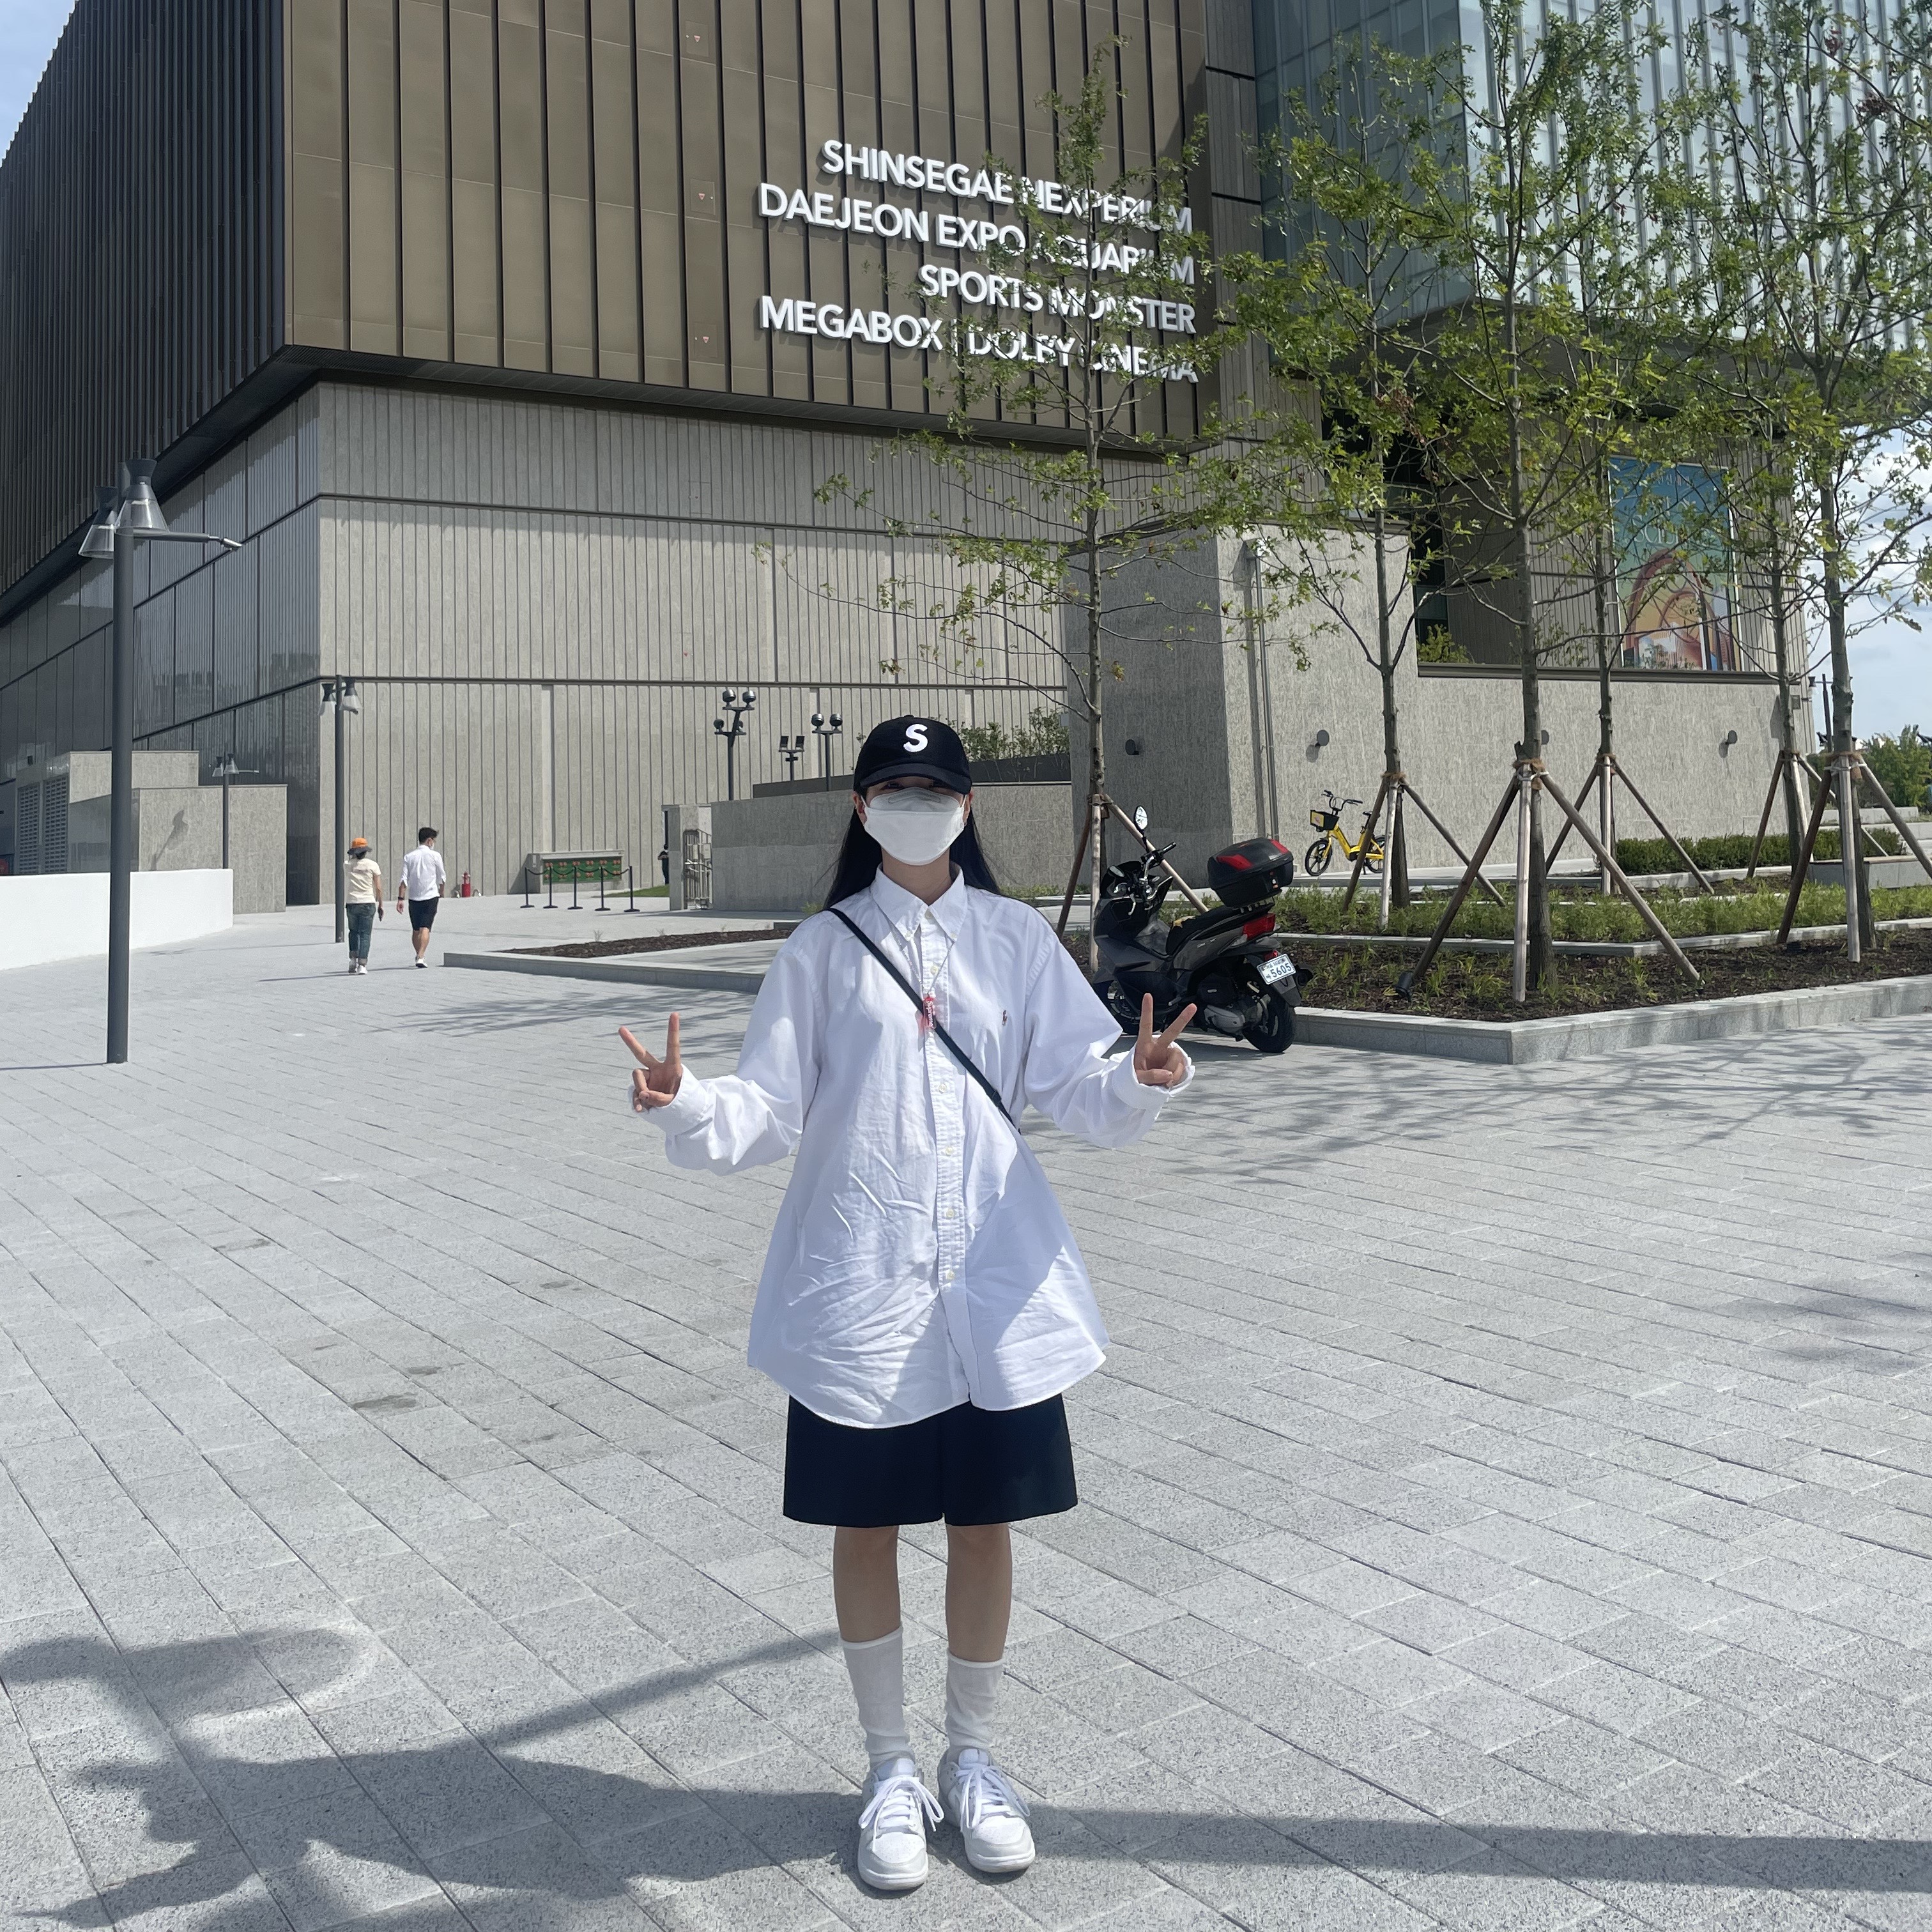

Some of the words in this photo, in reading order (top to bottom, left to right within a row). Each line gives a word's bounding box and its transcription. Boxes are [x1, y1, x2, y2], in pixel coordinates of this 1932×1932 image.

[822, 140, 1014, 204] SHINSEGAE
[758, 183, 930, 243] DAEJEON
[935, 213, 1026, 256] EXPO
[1032, 231, 1195, 285] QUARM
[918, 264, 1044, 312] SPORTS
[759, 295, 944, 351] MEGABOX
[965, 324, 1077, 367] DOLBY
[903, 723, 928, 753] S
[1270, 962, 1292, 978] 5605
